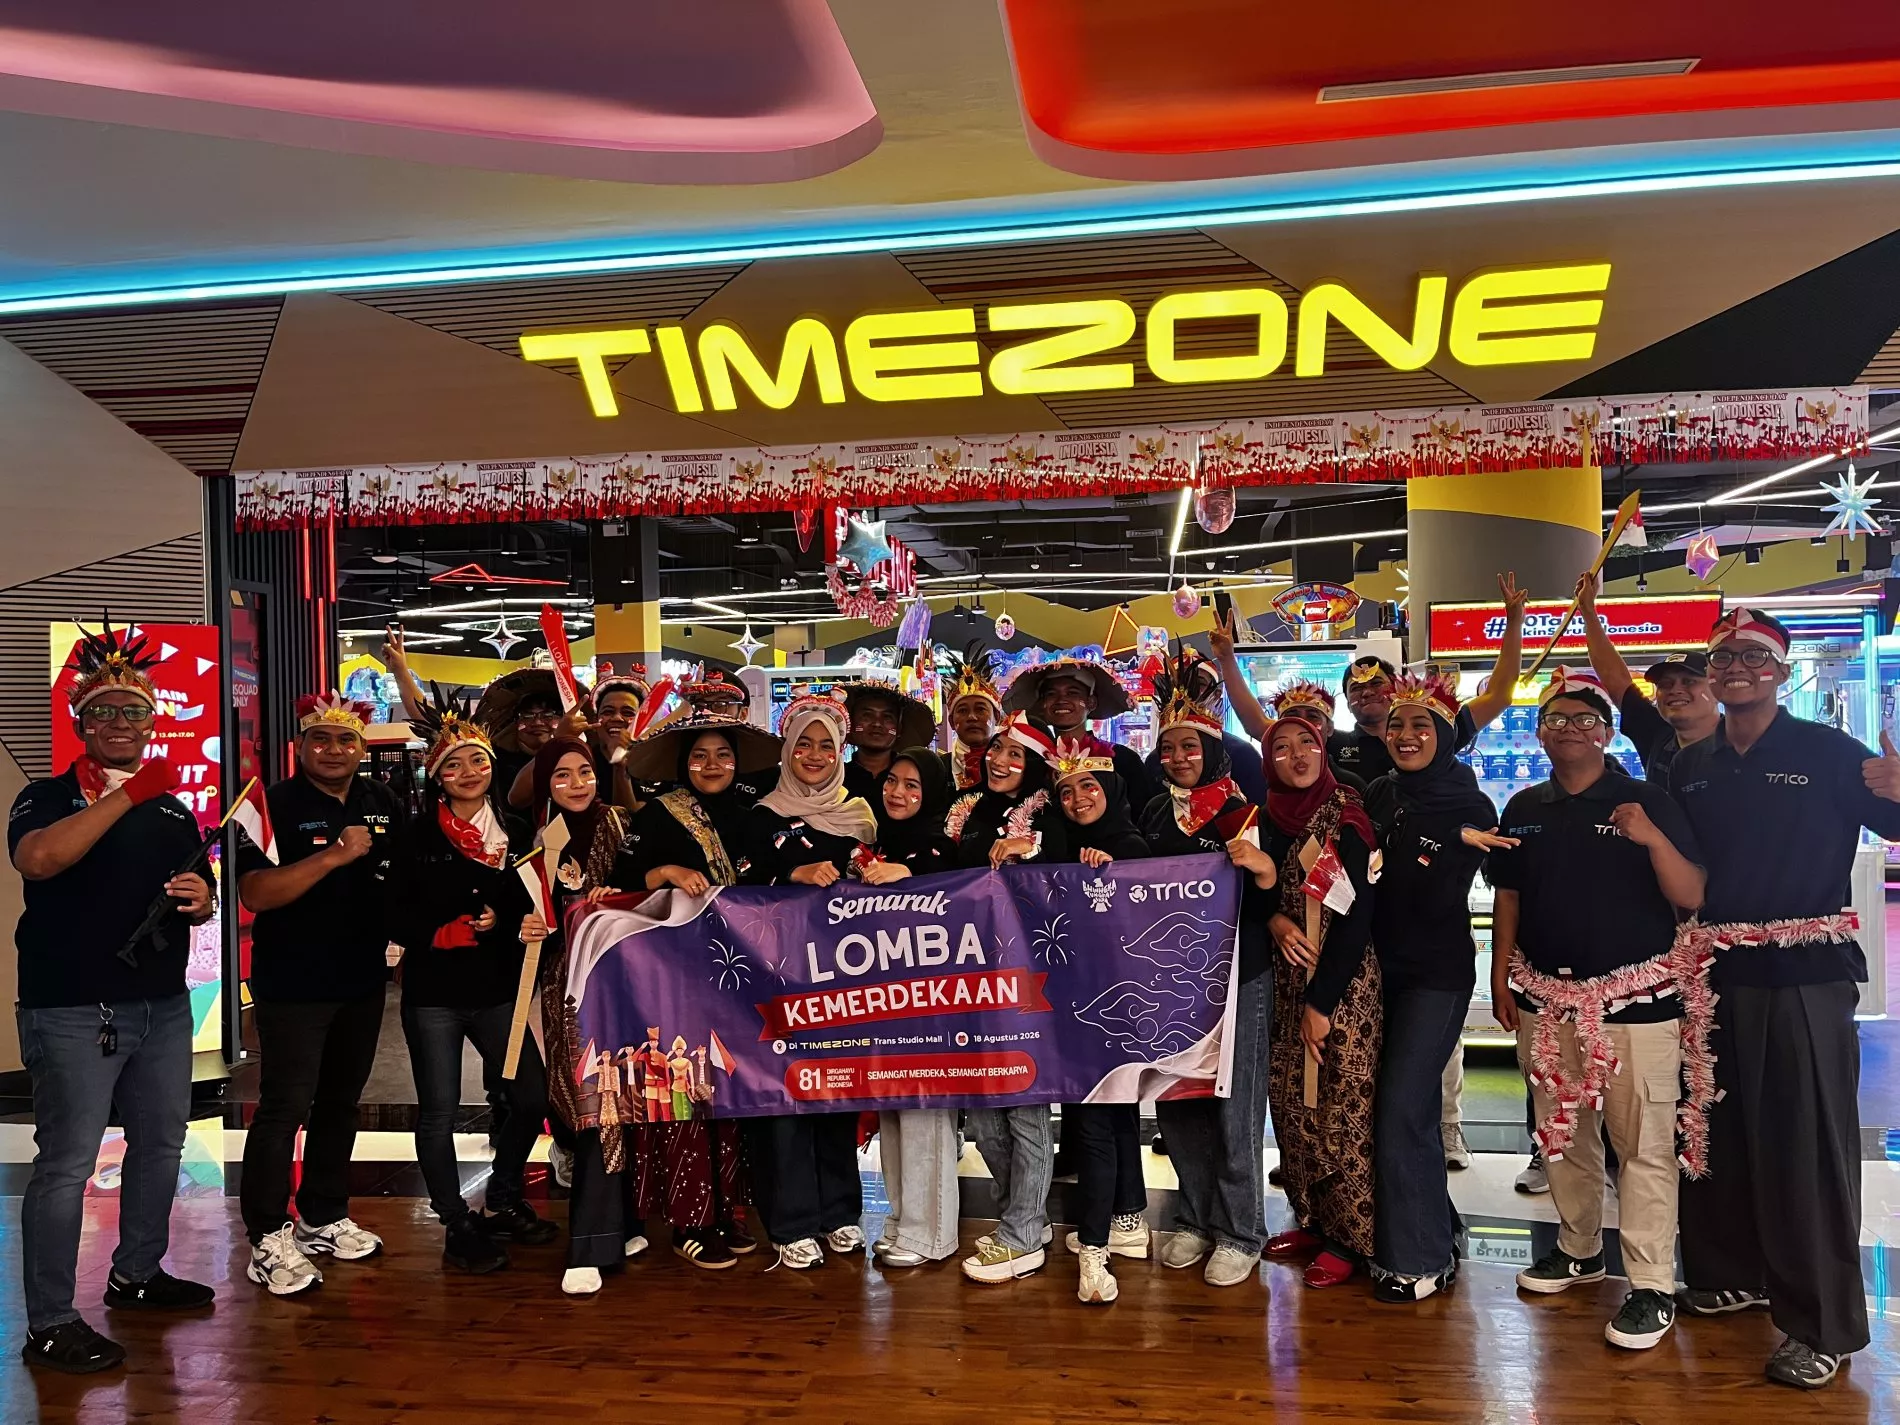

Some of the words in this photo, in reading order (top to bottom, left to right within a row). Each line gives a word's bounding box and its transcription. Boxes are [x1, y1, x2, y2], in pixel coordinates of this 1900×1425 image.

[519, 263, 1612, 418] TIMEZONE
[1714, 402, 1784, 421] INDONESIA
[1487, 414, 1551, 434] INDONESIA
[1269, 429, 1330, 447] INDONESIA
[1059, 442, 1118, 460] INDONESIA
[859, 453, 915, 470] INDONESIA
[481, 471, 533, 487] INDONESA
[666, 463, 719, 479] INDONESIA
[1789, 643, 1841, 653] ZONE
[552, 647, 568, 669] LOVE
[1765, 773, 1809, 785] TRICO
[736, 783, 757, 794] RICO
[1594, 824, 1622, 836] TRIC
[1199, 837, 1220, 852] TRIC
[1420, 836, 1441, 851] TRIC
[1149, 880, 1215, 901] TRICO
[827, 890, 951, 925] Semarak
[806, 923, 986, 984] LOMBA
[784, 976, 1018, 1027] KEMERDEKAAN
[789, 1042, 798, 1050] Di
[800, 1038, 871, 1050] TIMEZONE
[874, 1037, 896, 1045] Trans
[898, 1036, 924, 1044] Studio
[925, 1035, 943, 1043] Mall
[973, 1034, 982, 1042] 18
[983, 1033, 1018, 1043] Agustus
[1019, 1031, 1040, 1041] 2026
[826, 1067, 855, 1075] DIRGAHAYU
[867, 1069, 908, 1080] SEMANGAT
[909, 1067, 947, 1079] MERDEKA,
[947, 1067, 987, 1078] SEMANGAT
[988, 1065, 1028, 1077] BERKARYA
[799, 1068, 821, 1091] 81
[826, 1081, 853, 1089] INDONESIA
